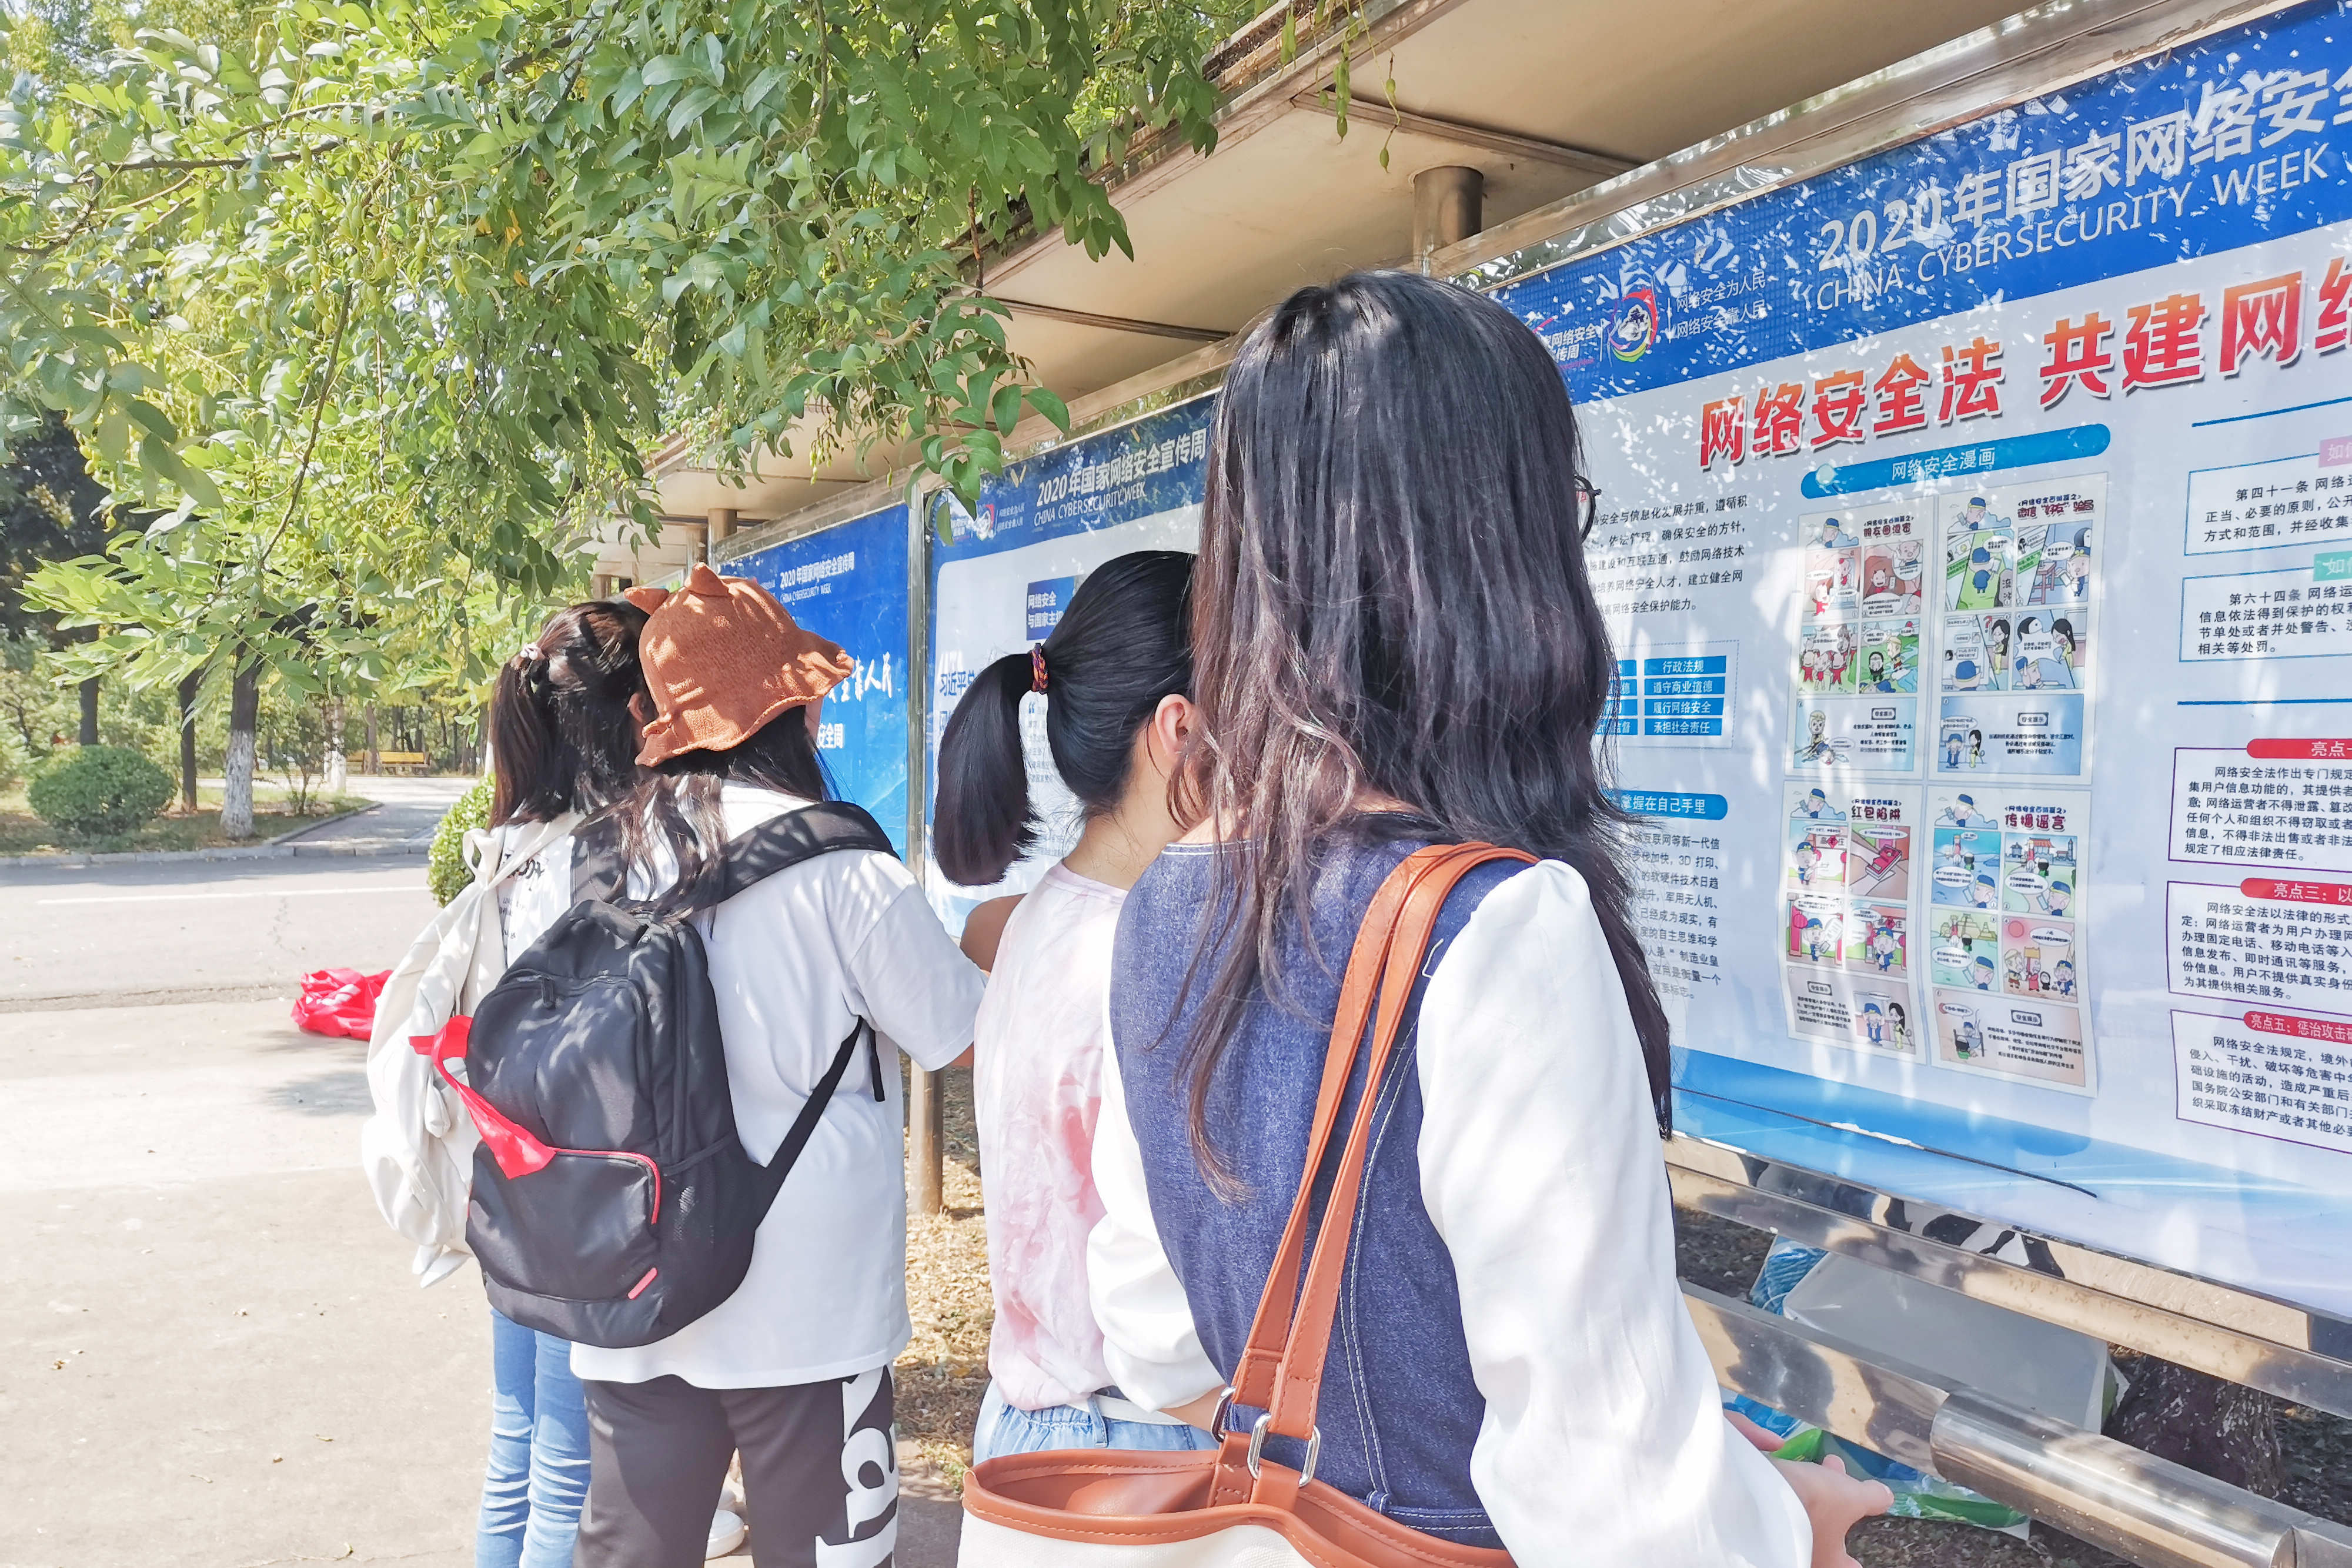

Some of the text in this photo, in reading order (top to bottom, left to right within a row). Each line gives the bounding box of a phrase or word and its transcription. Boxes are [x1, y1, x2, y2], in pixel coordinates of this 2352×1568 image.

[1816, 143, 2330, 311] CHINA CYBERSECURITY WEEK
[1676, 270, 1766, 312] 网络安全为人民
[1676, 300, 1766, 339] 网络安全靠人民
[1699, 337, 2004, 467] 网络安全法
[1037, 428, 1207, 507] 2020年国家网络安全宣传周
[1892, 447, 1995, 480] 网络安全漫画
[1034, 507, 1056, 527] CHINA
[1058, 489, 1124, 519] CYBERSECURITY
[1124, 481, 1147, 500] WEEK
[2236, 480, 2308, 502] 第四十一条
[2204, 516, 2352, 542] 方式和范围，并经收集
[1596, 569, 1743, 593] 培养网络安全人才，建立健全网
[2229, 588, 2301, 606] 第六十四条
[2198, 640, 2276, 655] 相关等处罚。
[1662, 660, 1705, 674] 行政法规
[1653, 680, 1713, 694] 遵守商业道德
[1653, 721, 1710, 734] 承担社会责任
[2186, 813, 2352, 830] 任何个人和组织不得窃取或者
[2184, 842, 2304, 861] 规定了相应法律责任。
[2207, 902, 2352, 925] 网络安全法以法律的形式
[2181, 946, 2347, 975] 信息发布、即时通讯等服务，
[2184, 976, 2291, 999] 为其提供相关服务。
[2213, 1036, 2352, 1067] 网络安全法规定，境外
[2190, 1065, 2352, 1101] 础设施的活动，造成严重后
[2192, 1080, 2352, 1119] 国务院公安部门和有关部门
